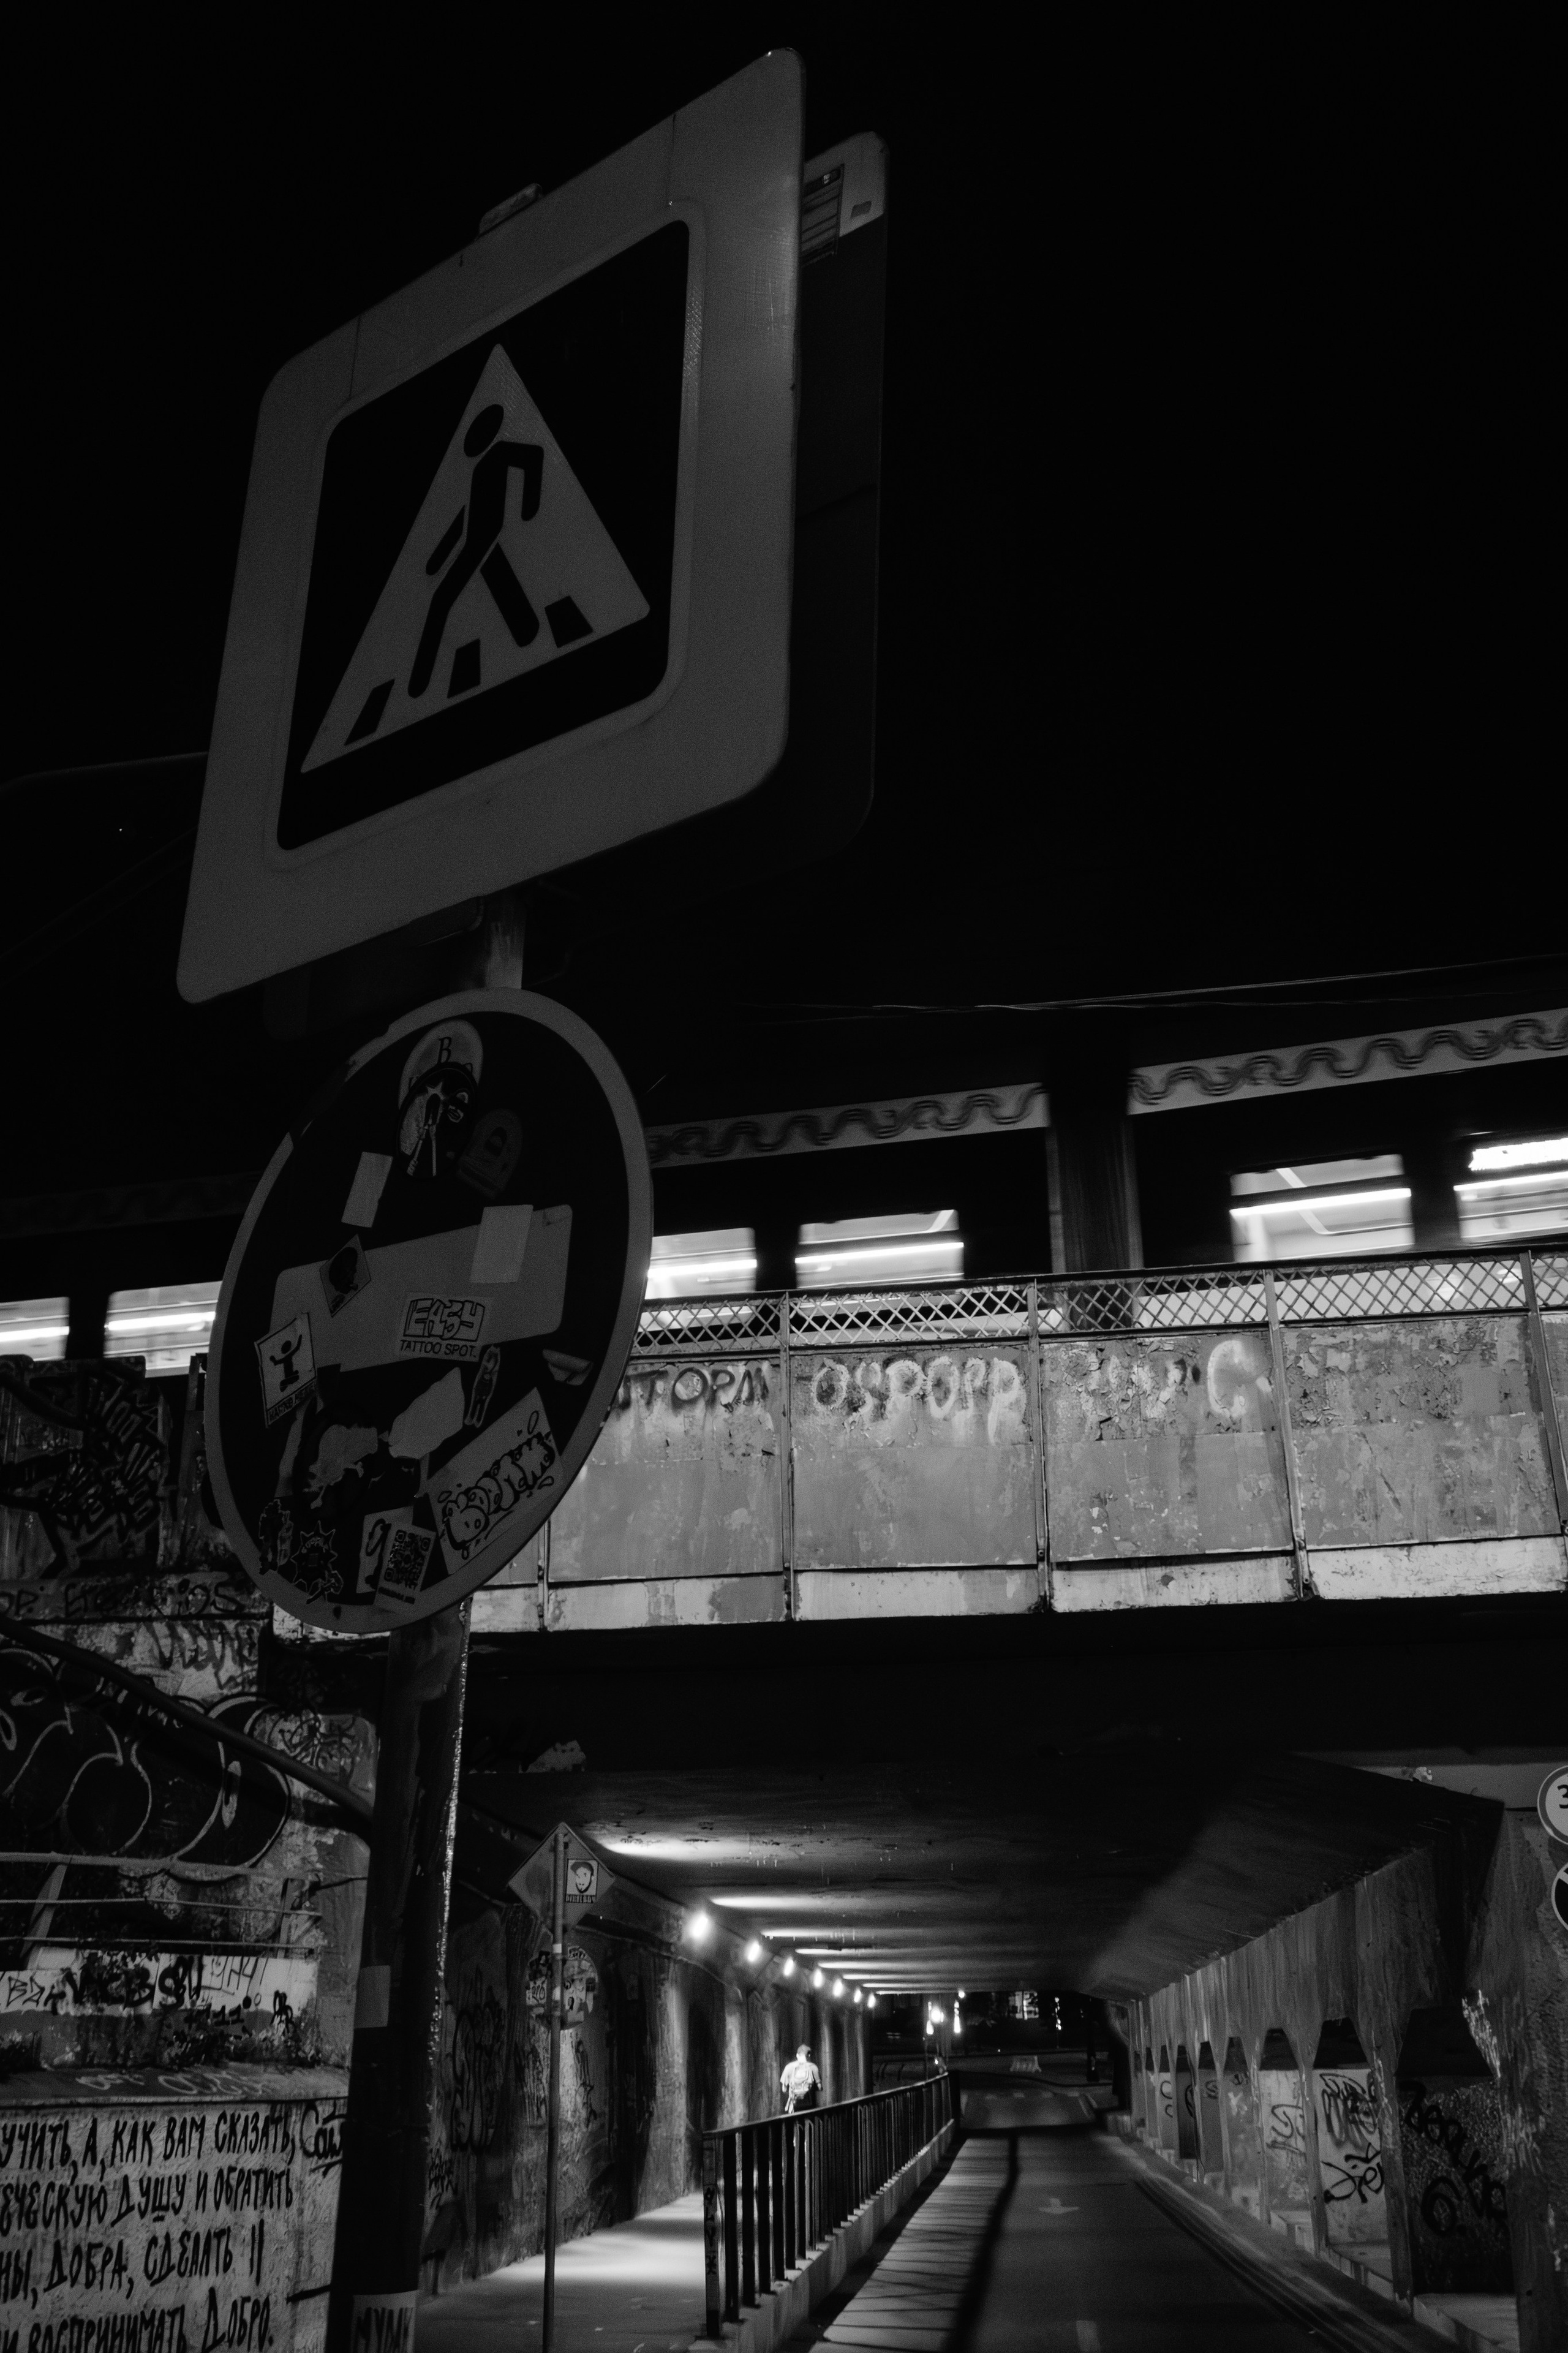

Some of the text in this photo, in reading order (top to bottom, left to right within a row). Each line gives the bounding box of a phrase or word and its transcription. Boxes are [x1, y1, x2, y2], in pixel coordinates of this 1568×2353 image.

[399, 1339, 442, 1354] TATTOO
[402, 1297, 486, 1343] EASY
[0, 2110, 295, 2185] УЧИТЬ, А, КАК ВАМ СКАЗАТЬ,
[0, 2166, 293, 2236] ЕЧЕСКУЮ ДУШУ И ОБРАТИТЬ
[43, 2239, 134, 2299] ДОБРА,
[144, 2226, 233, 2287] СДЕЛАТЬ
[28, 2305, 186, 2353] ВОСПРИНИМАТЬ
